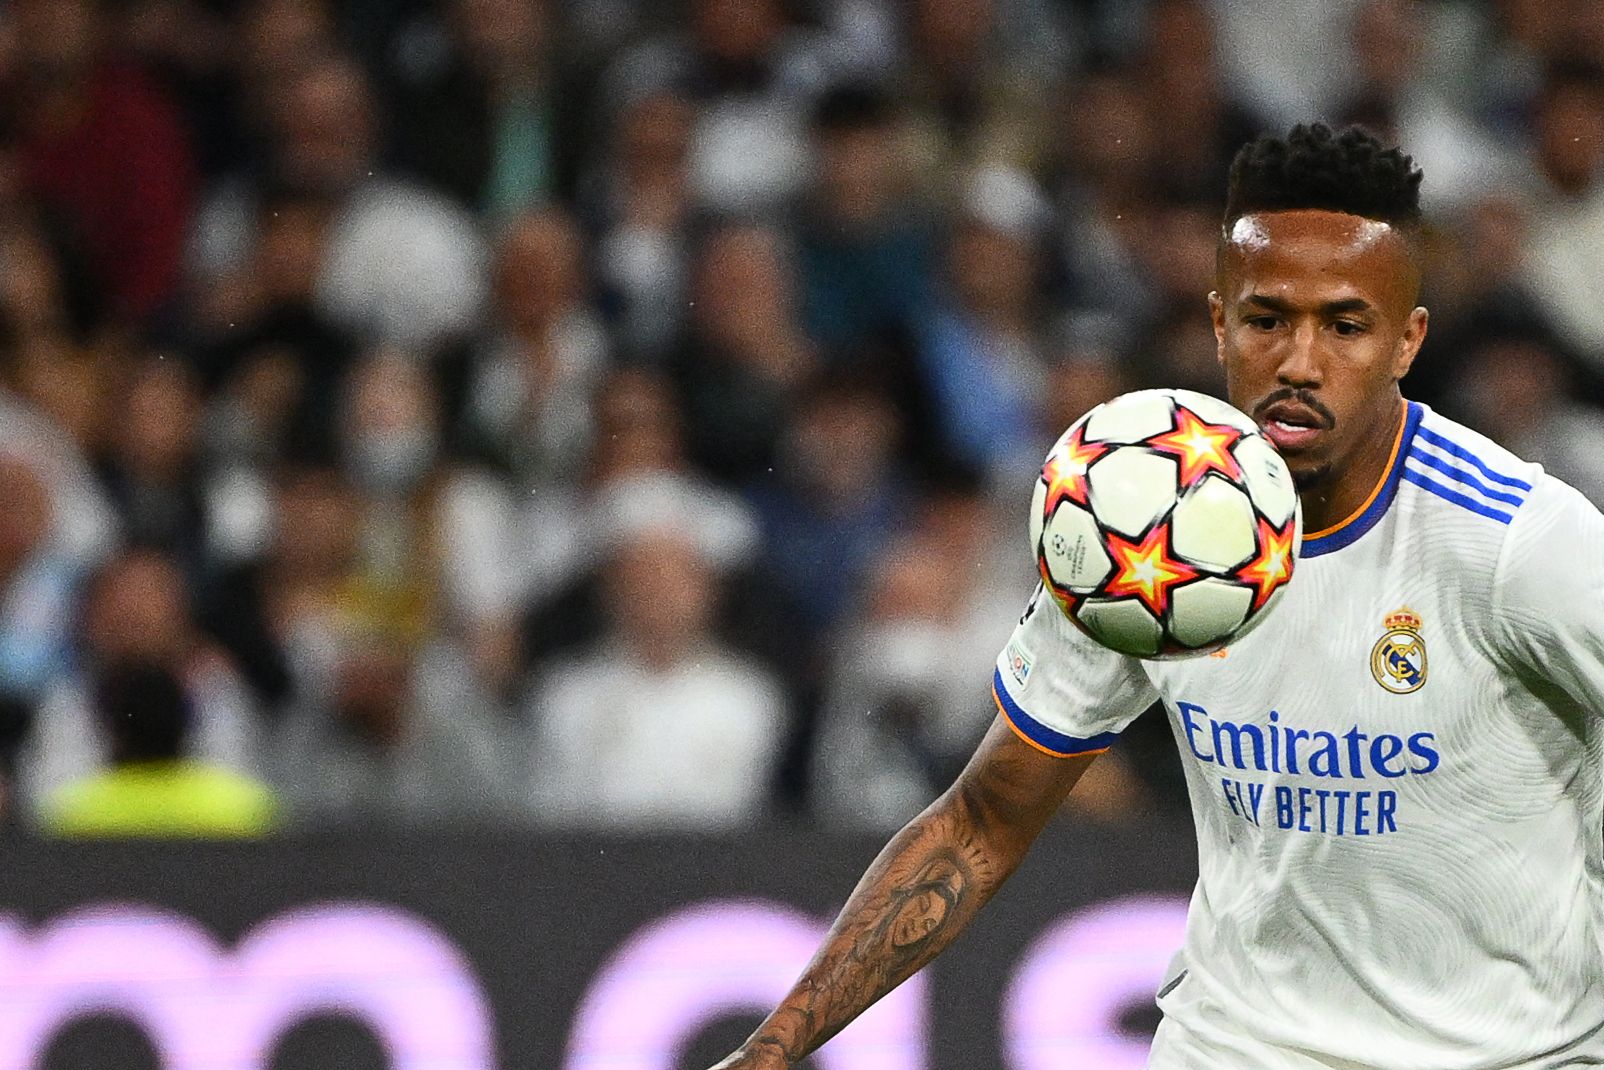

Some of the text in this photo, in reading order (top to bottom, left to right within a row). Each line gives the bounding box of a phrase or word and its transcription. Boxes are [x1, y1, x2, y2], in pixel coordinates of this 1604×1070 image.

[1176, 701, 1440, 779] Emirates
[1222, 777, 1398, 836] FLY BETTER
